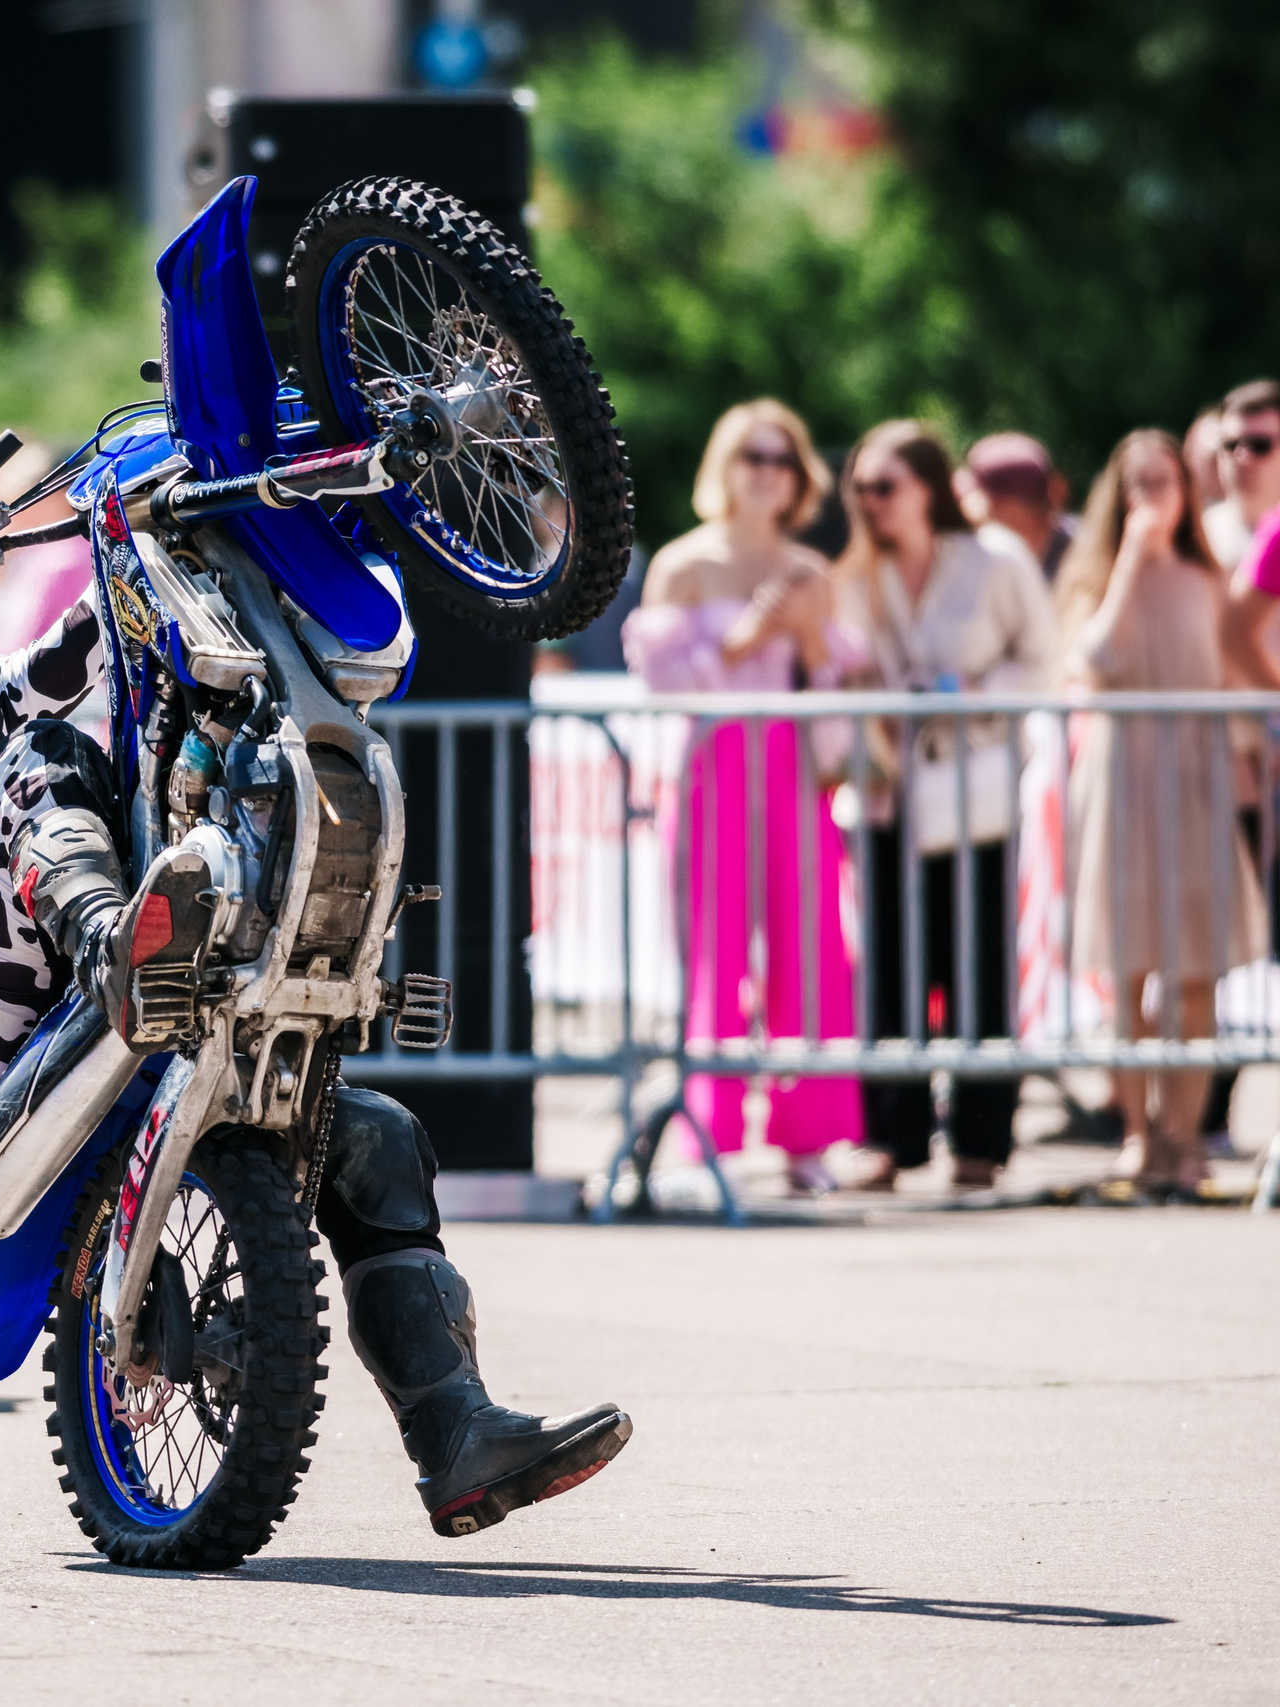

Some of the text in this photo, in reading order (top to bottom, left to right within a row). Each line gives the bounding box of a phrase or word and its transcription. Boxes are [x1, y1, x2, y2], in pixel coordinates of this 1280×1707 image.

[161, 306, 176, 433] ШКОЛАМОТОКРОССА.РФ
[187, 478, 230, 497] CRAZY
[71, 1199, 111, 1299] KENDA CARLSBAD
